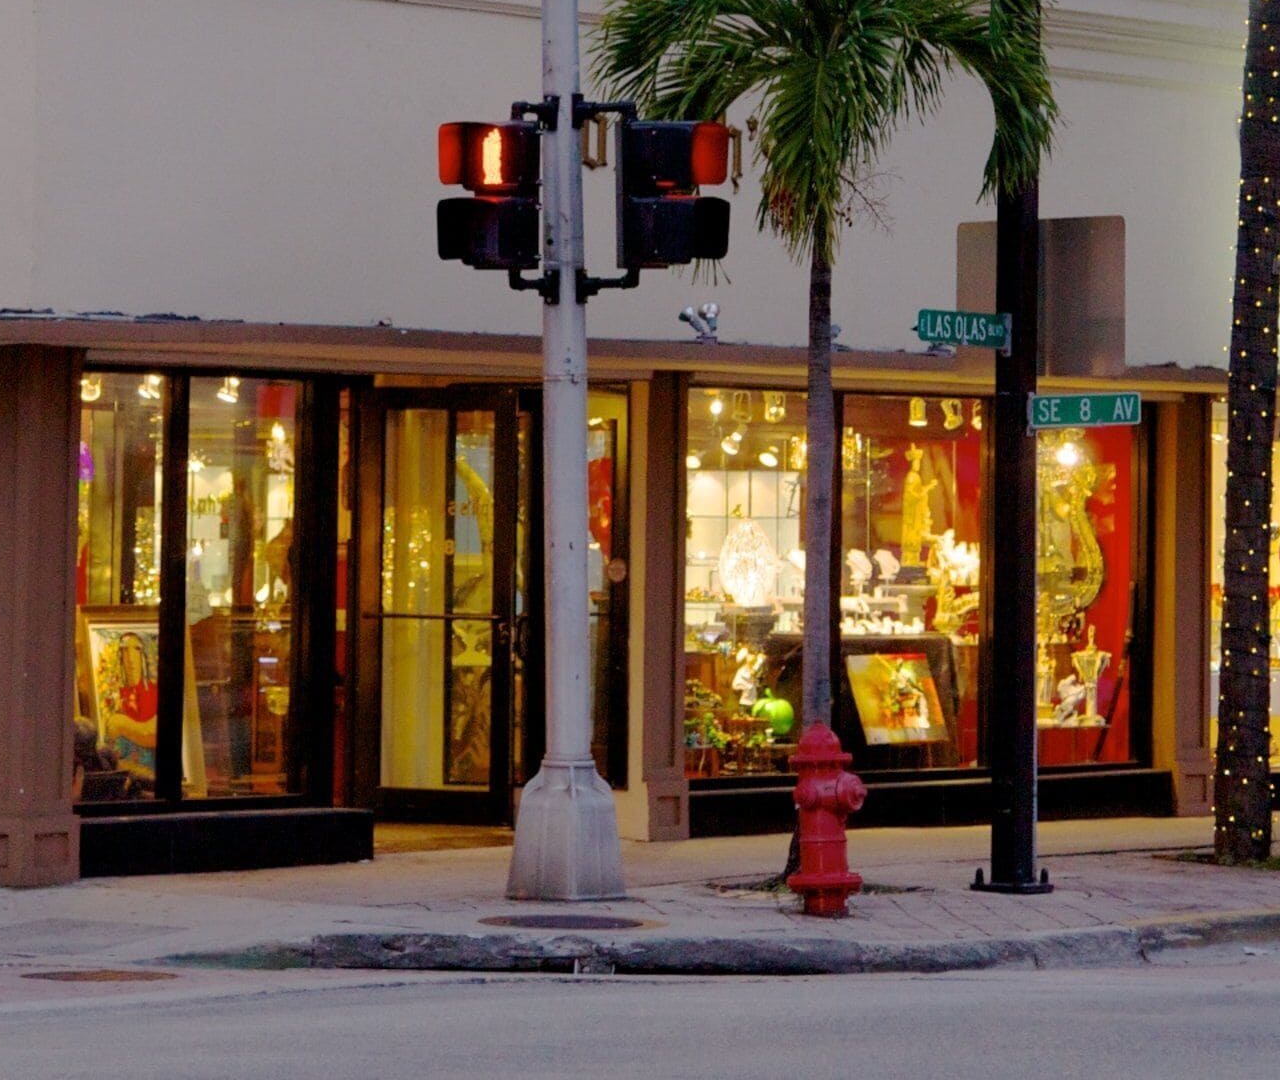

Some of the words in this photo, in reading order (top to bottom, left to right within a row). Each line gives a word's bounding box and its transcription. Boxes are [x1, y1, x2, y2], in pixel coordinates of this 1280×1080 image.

[920, 318, 926, 332] E
[927, 314, 951, 338] LAS
[955, 316, 986, 342] OLAS
[987, 324, 1004, 337] BLVD
[1038, 398, 1061, 423] SE
[1080, 397, 1091, 421] 8
[1113, 396, 1134, 420] AV
